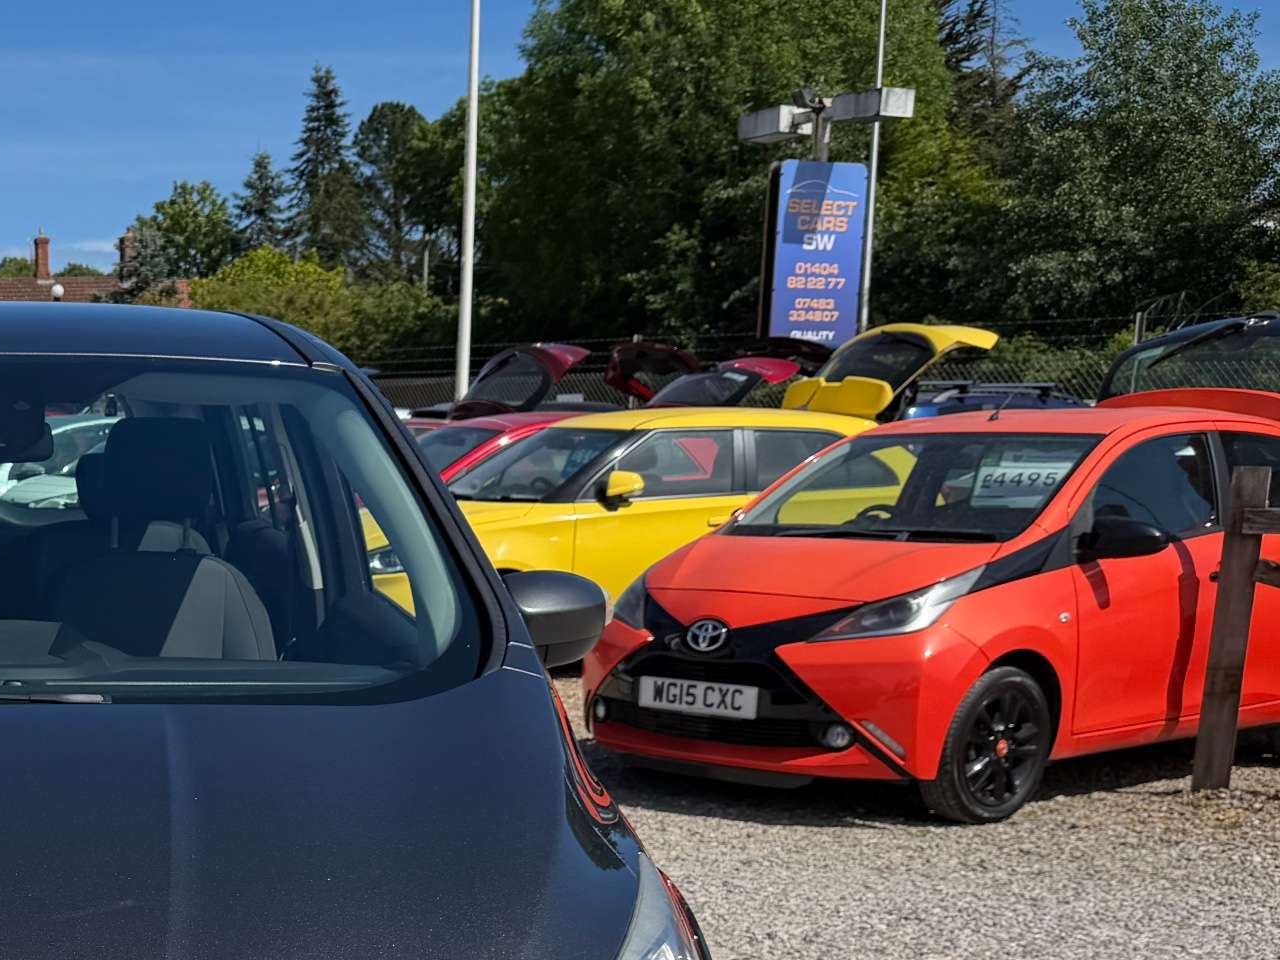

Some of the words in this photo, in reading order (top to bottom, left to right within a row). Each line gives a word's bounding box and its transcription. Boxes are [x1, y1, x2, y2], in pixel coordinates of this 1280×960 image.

[789, 199, 857, 216] SELECT
[797, 215, 849, 232] CARS
[802, 233, 836, 251] SW
[795, 262, 839, 275] 01404
[790, 330, 836, 341] QUALITY
[653, 680, 697, 706] WG15
[703, 686, 743, 711] CXC
